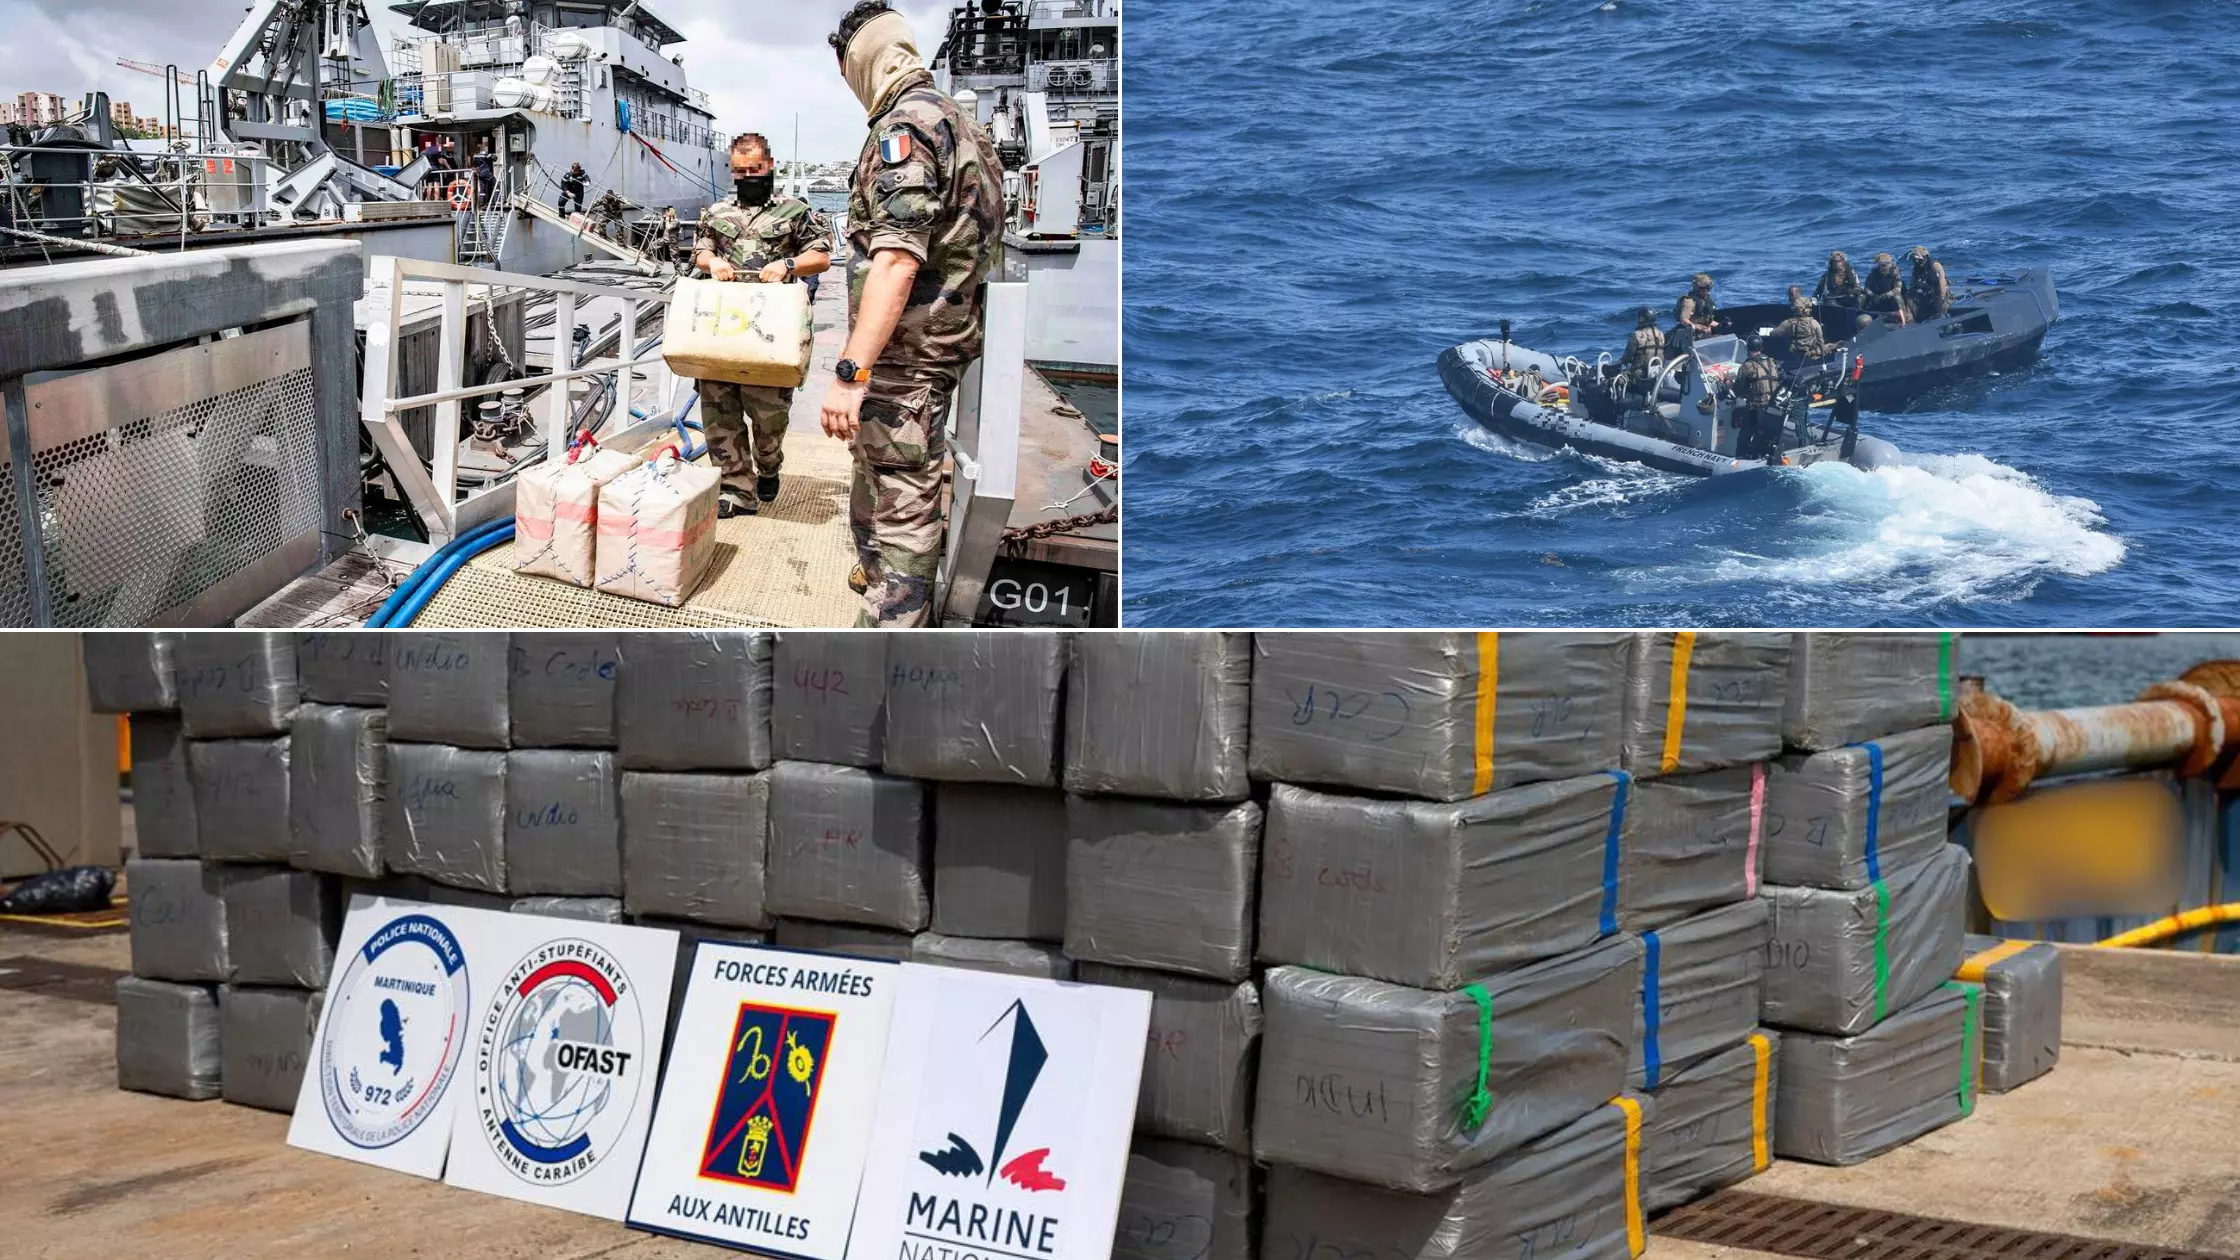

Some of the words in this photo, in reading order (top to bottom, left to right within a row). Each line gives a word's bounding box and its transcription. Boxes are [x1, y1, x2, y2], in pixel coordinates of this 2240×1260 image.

[1671, 445, 1705, 459] FRENCH
[1703, 453, 1729, 463] NAVY
[990, 579, 1069, 616] G01
[794, 664, 849, 700] 442
[370, 922, 407, 954] POLICE
[408, 922, 459, 967] NATIONALE
[374, 975, 437, 996] MARTINIQUE
[714, 960, 788, 987] FORCES
[791, 968, 874, 997] ARMÉES
[479, 1001, 502, 1072] OFFICE
[557, 1043, 632, 1077] OFAST
[364, 1085, 392, 1106] 972
[482, 1107, 529, 1175] ANTENNE
[667, 1193, 712, 1221] AUX
[713, 1203, 811, 1240] ANTILLES
[906, 1191, 1059, 1254] MARINE
